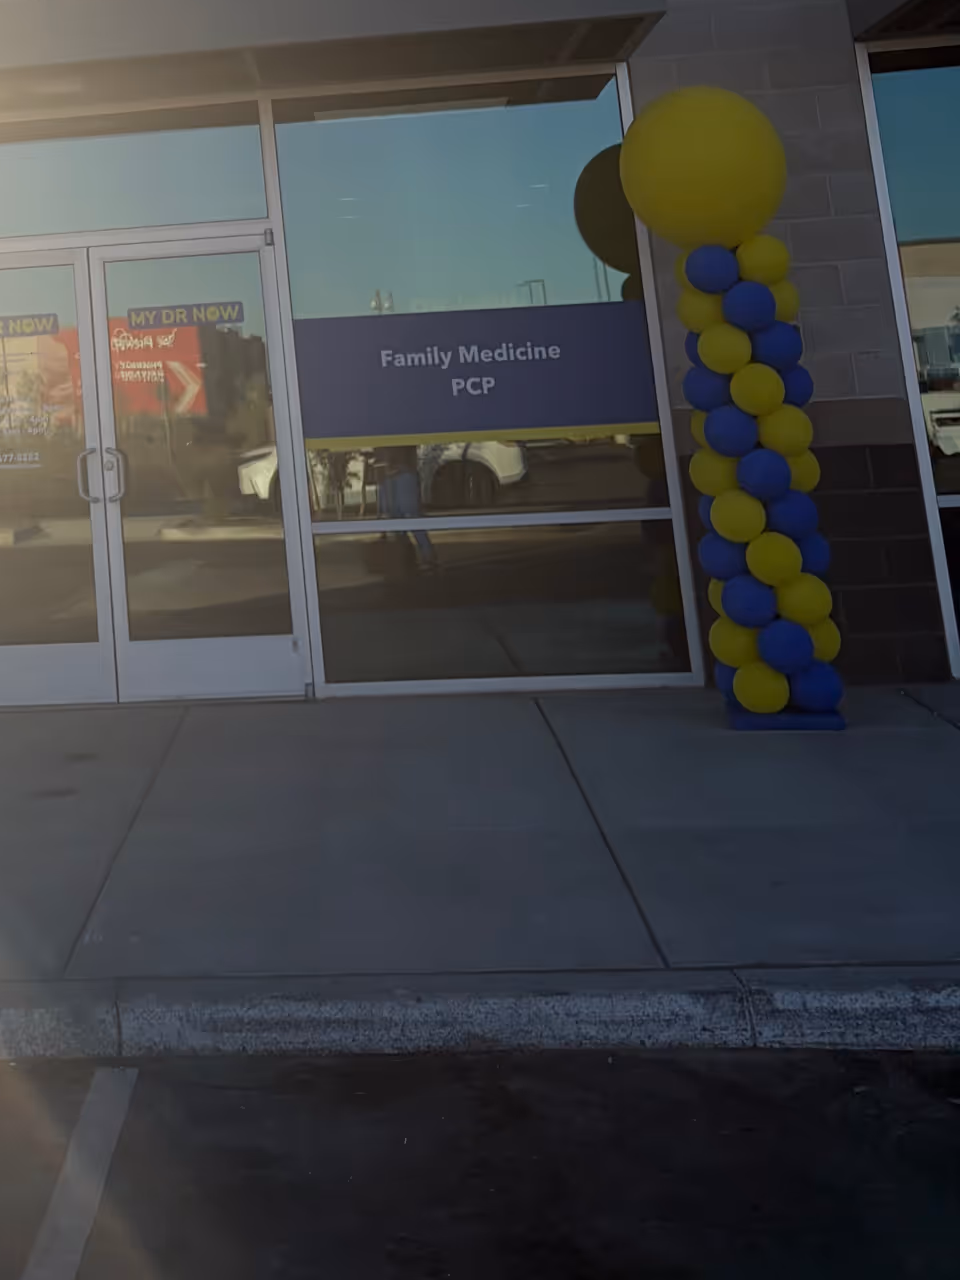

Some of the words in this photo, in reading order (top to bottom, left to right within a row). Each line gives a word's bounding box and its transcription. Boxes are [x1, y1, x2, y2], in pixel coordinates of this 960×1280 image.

[9, 316, 54, 334] NOW
[131, 310, 156, 327] MY
[161, 308, 187, 324] DR
[193, 304, 239, 323] NOW
[380, 346, 452, 370] Family
[458, 342, 561, 363] Medicine
[451, 376, 496, 396] PCP
